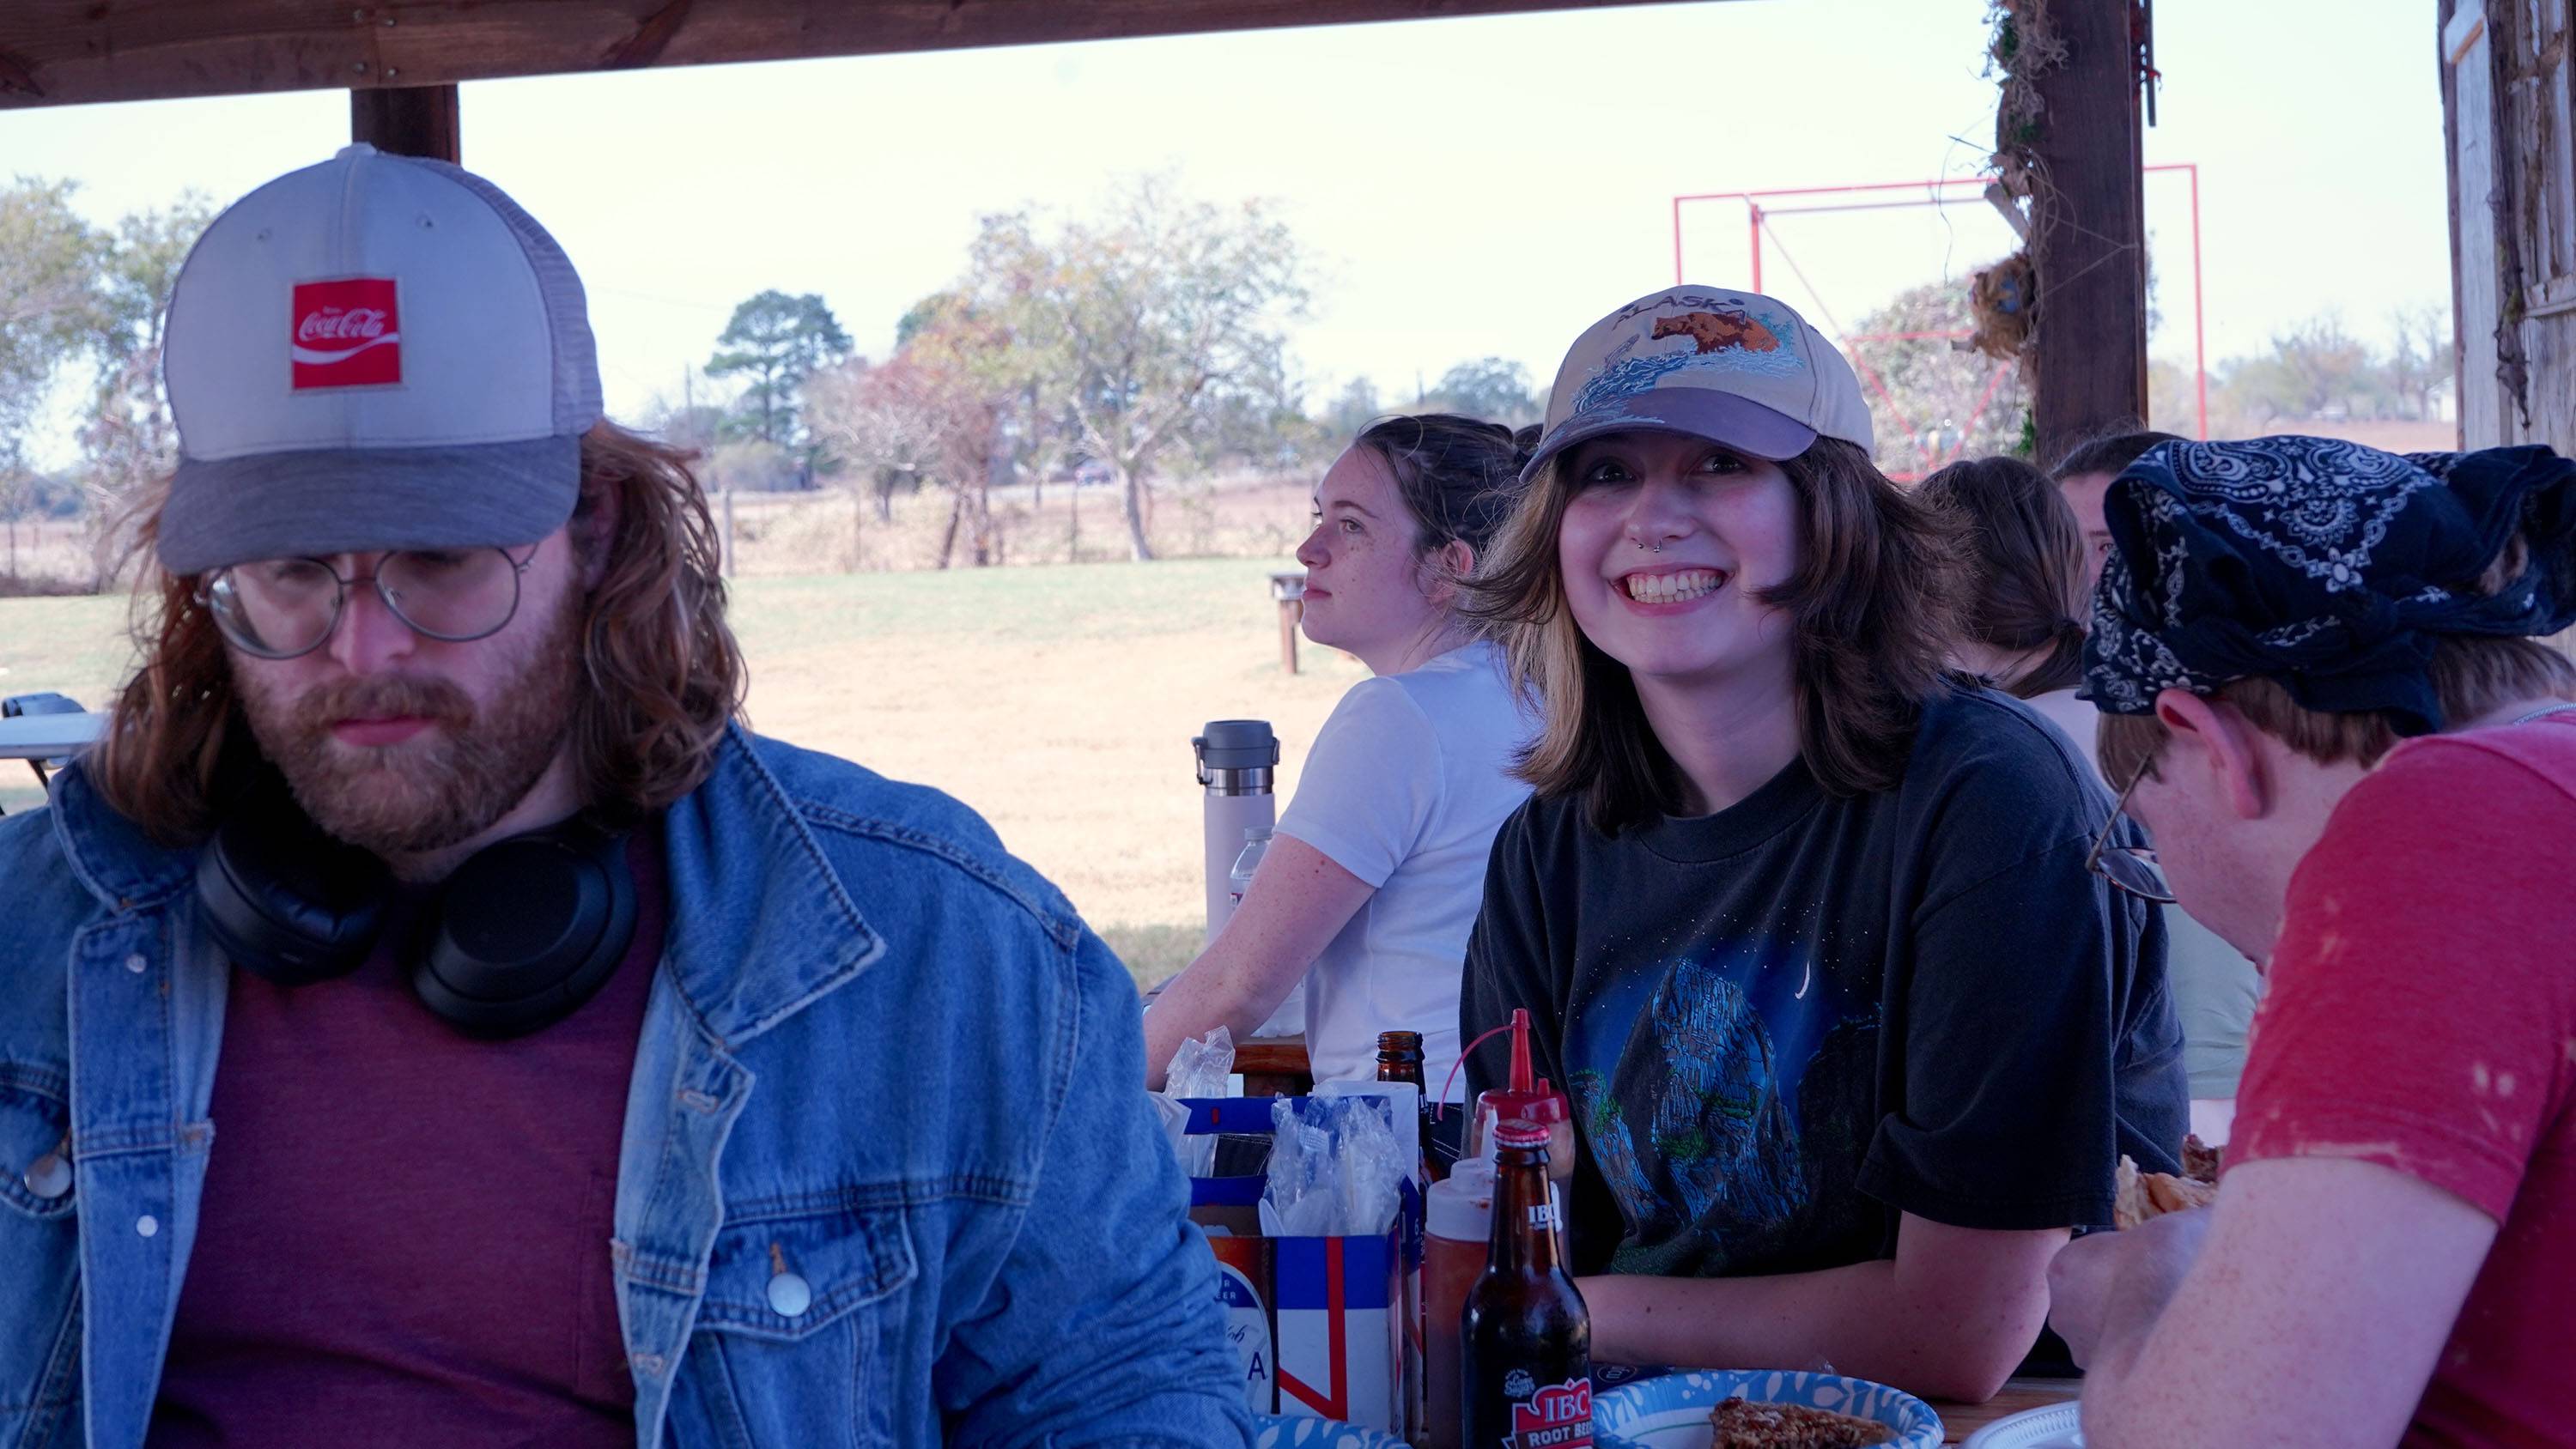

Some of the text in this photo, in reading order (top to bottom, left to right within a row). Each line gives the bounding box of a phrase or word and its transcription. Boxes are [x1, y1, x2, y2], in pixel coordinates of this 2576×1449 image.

[1612, 295, 1747, 330] ALASKA
[1545, 1390, 1588, 1422] IBC
[1528, 1426, 1571, 1447] ROOT
